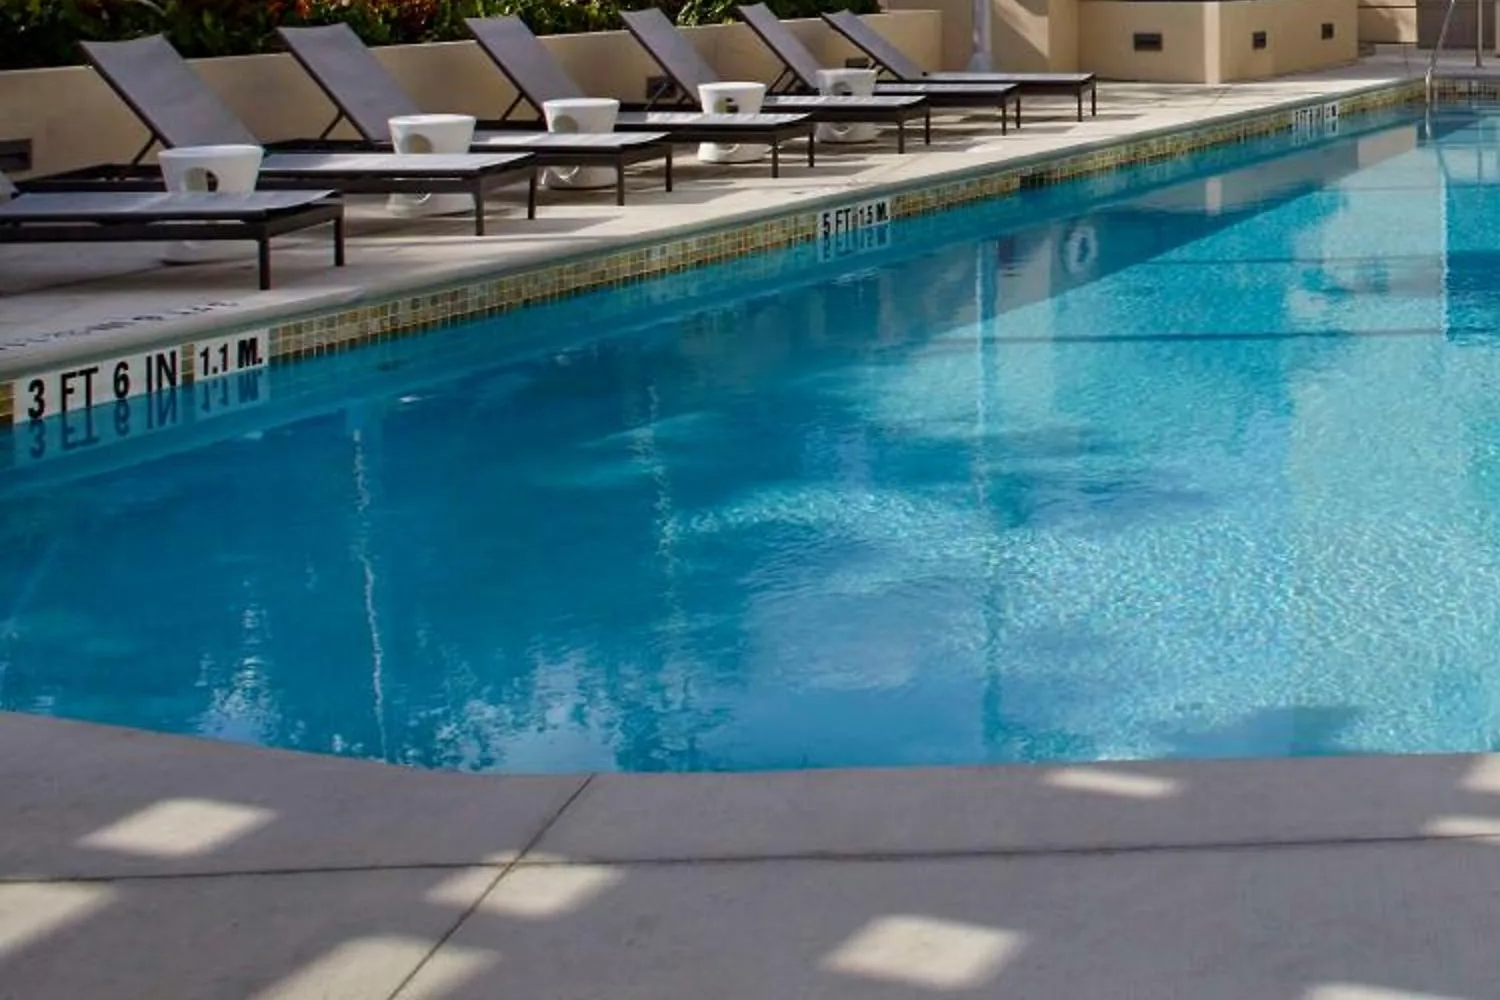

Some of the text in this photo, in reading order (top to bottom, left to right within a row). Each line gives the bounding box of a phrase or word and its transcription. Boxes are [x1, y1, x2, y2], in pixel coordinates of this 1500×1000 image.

[822, 212, 831, 237] 5
[835, 207, 851, 233] FT
[200, 337, 263, 376] 1.1 M.
[27, 351, 177, 420] 3 FT 6 IN
